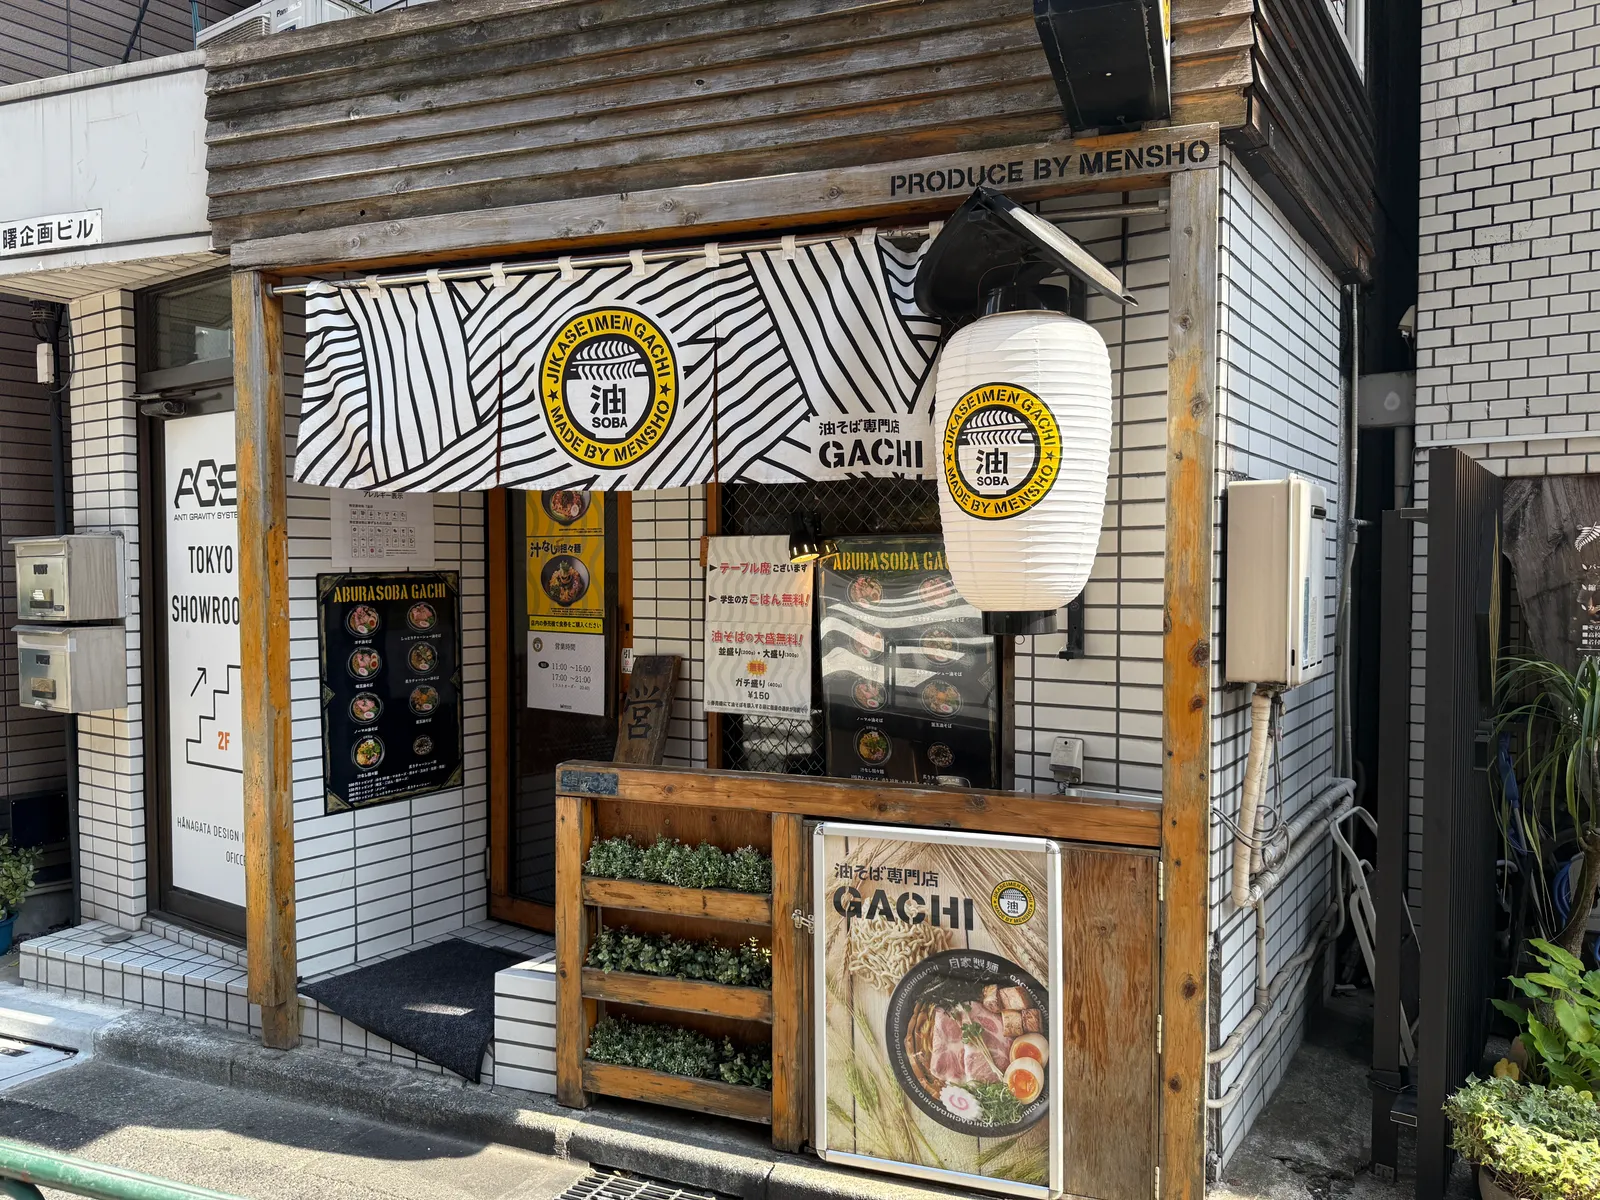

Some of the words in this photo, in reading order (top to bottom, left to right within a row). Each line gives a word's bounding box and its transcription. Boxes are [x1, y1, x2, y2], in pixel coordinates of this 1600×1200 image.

[890, 160, 1024, 197] PRODUCE
[1034, 155, 1072, 180] BY
[1078, 139, 1210, 175] MENSHO
[3, 219, 93, 249] 曙企画ビル
[546, 314, 634, 384] JIKASEIMEN
[634, 322, 671, 378] GACHI
[590, 384, 626, 415] 油
[592, 416, 628, 429] SOBA
[819, 418, 900, 436] 油そば専門店
[946, 389, 1021, 449] JIKASEIMEN
[1021, 398, 1056, 446] GACHI
[550, 406, 584, 453] MADE
[584, 443, 611, 462] BY
[613, 400, 670, 463] MENSHO
[818, 438, 923, 469] GACHI
[976, 448, 1008, 475] 油
[174, 459, 237, 509] AGS
[947, 466, 972, 506] MADE
[970, 499, 991, 514] BY
[994, 464, 1054, 515] MENSHO
[977, 476, 1009, 486] SOBA
[173, 512, 189, 522] ANTI
[189, 511, 216, 521] GRAVITY
[188, 545, 233, 574] TOKYO
[833, 551, 919, 571] ABURASOBA
[333, 583, 409, 603] ABURASOBA
[411, 583, 446, 599] GACHI
[172, 595, 240, 626] SHOWROO
[554, 642, 576, 652] 営業時間
[552, 662, 568, 671] 11:00
[552, 673, 568, 682] 17:00
[748, 662, 766, 673] 無料
[748, 691, 770, 701] ¥150
[623, 685, 663, 741] 営
[217, 731, 231, 751] 2F
[213, 825, 240, 842] DESIGN
[834, 862, 939, 888] 油そば専門店
[833, 886, 974, 931] GACHI
[1006, 900, 1019, 911] 油
[949, 957, 1000, 974] 自家製麺
